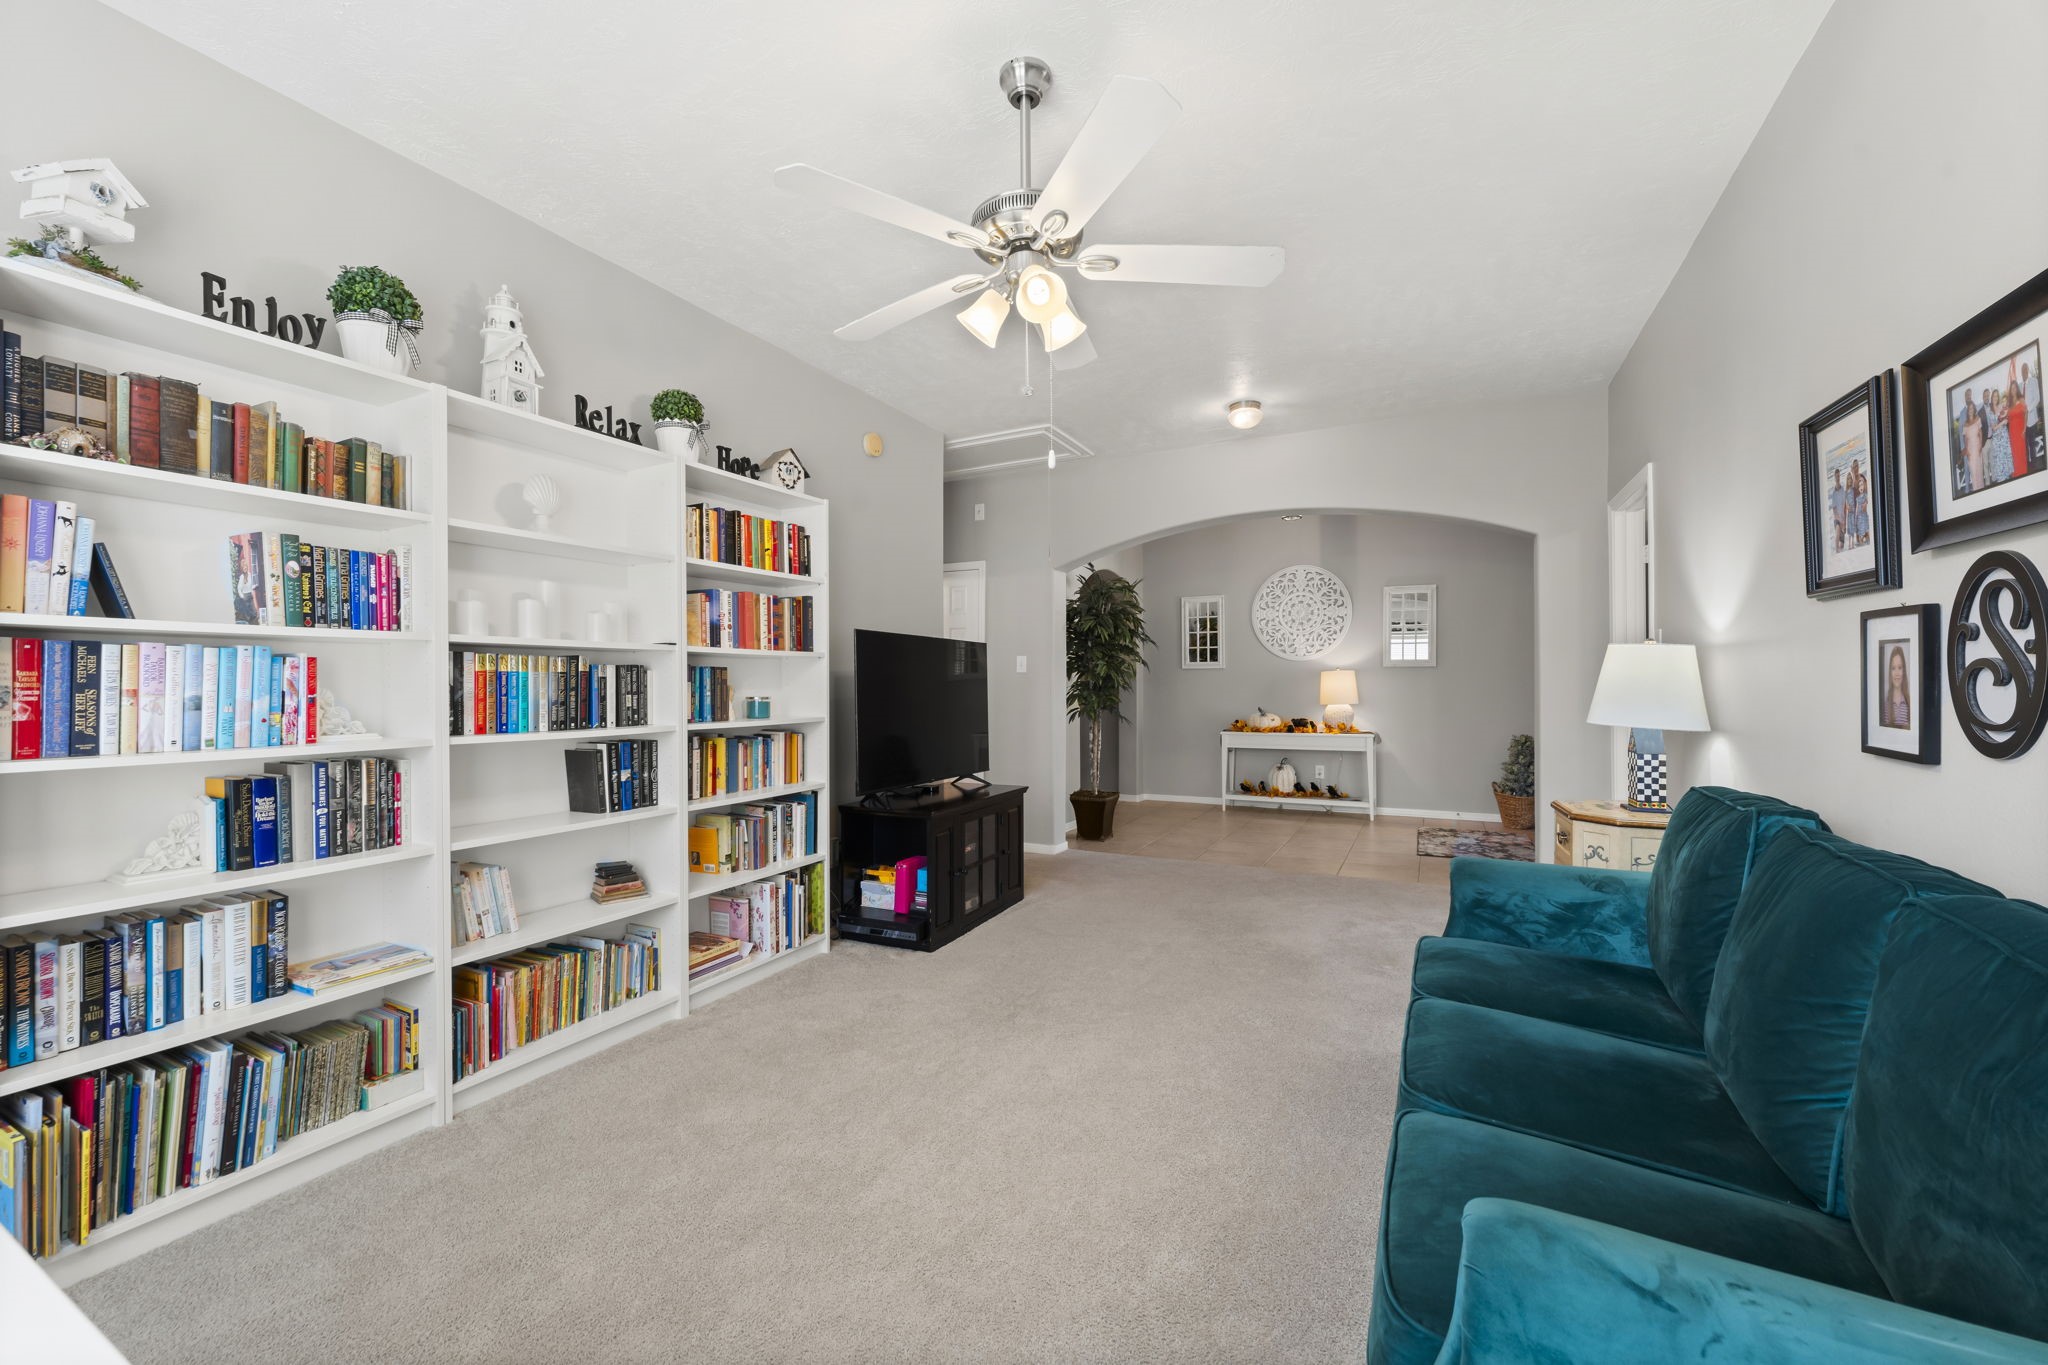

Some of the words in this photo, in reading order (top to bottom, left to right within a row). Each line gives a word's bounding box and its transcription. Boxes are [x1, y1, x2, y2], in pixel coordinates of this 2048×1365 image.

[201, 272, 327, 349] Enjoy
[5, 348, 13, 379] LOYALTY
[5, 412, 13, 437] COMEY
[575, 394, 643, 446] Relax
[716, 445, 760, 480] Hope
[36, 503, 49, 533] JOHANNA
[33, 533, 47, 558] LINDSEY
[315, 547, 325, 572] Martha
[341, 551, 349, 575] Martha
[316, 573, 326, 599] Grimes
[341, 576, 350, 600] Grimes
[76, 646, 87, 684] MICHAELS
[87, 655, 97, 675] FERN
[75, 693, 85, 712] HER
[85, 689, 98, 727] SEASONS
[74, 712, 85, 732] LIFE
[84, 727, 97, 737] of
[318, 767, 326, 787] MARTHA
[241, 783, 251, 800] Such
[242, 800, 251, 826] Devoted
[281, 807, 290, 818] The
[281, 819, 290, 830] Old
[281, 830, 290, 848] Silent
[319, 828, 327, 848] MATTER
[233, 907, 246, 936] BARBARA
[275, 911, 285, 926] NORA
[15, 949, 31, 978] SANDRA
[66, 948, 75, 972] SANDRA
[84, 944, 104, 974] SANDRA
[109, 941, 122, 965] SANDRA
[233, 937, 246, 966] WALTERS
[40, 952, 55, 977] SANDRA
[109, 965, 121, 988] BROWN
[14, 977, 31, 1008] BROWN
[40, 976, 55, 1001] BROWN
[66, 972, 75, 993] BROWN
[84, 974, 104, 1002] BROWN
[17, 1008, 30, 1023] THE
[39, 1005, 55, 1030] CHARADE
[66, 1000, 75, 1020] FRENCH
[109, 989, 122, 1026] UNSPEAKABLE
[16, 1022, 30, 1050] WITNESS
[66, 1021, 74, 1035] SILK
[235, 1065, 244, 1103] DISCOVERING
